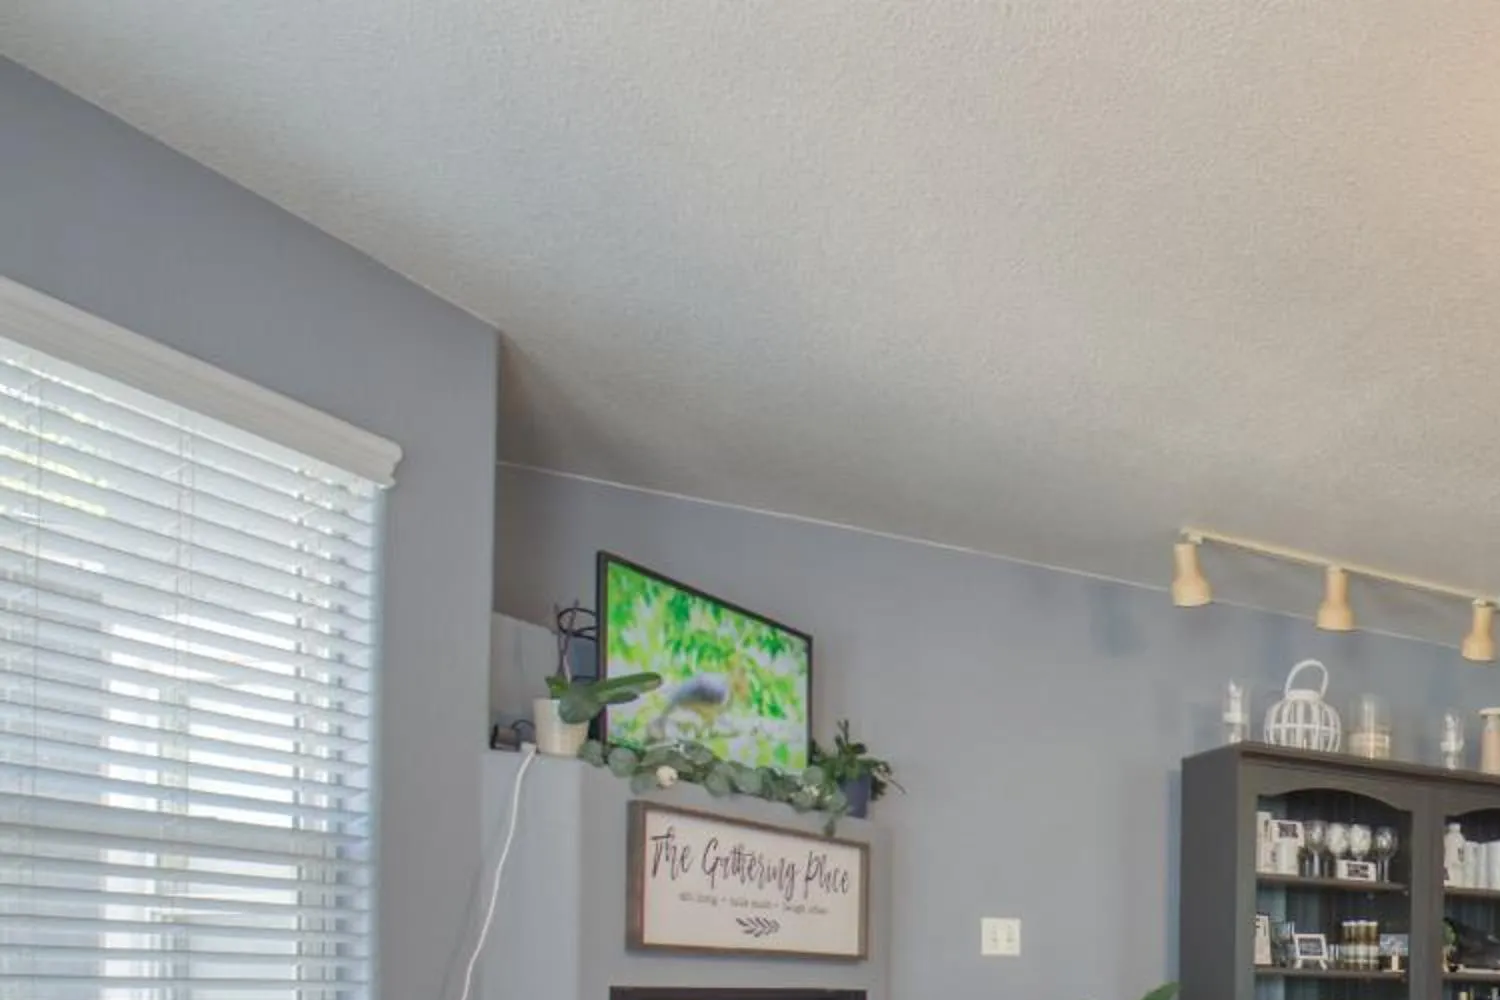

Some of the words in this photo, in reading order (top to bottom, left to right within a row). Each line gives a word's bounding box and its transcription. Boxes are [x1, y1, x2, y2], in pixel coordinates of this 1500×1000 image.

[650, 826, 693, 881] The
[702, 838, 796, 902] Gathering
[803, 851, 849, 899] Place
